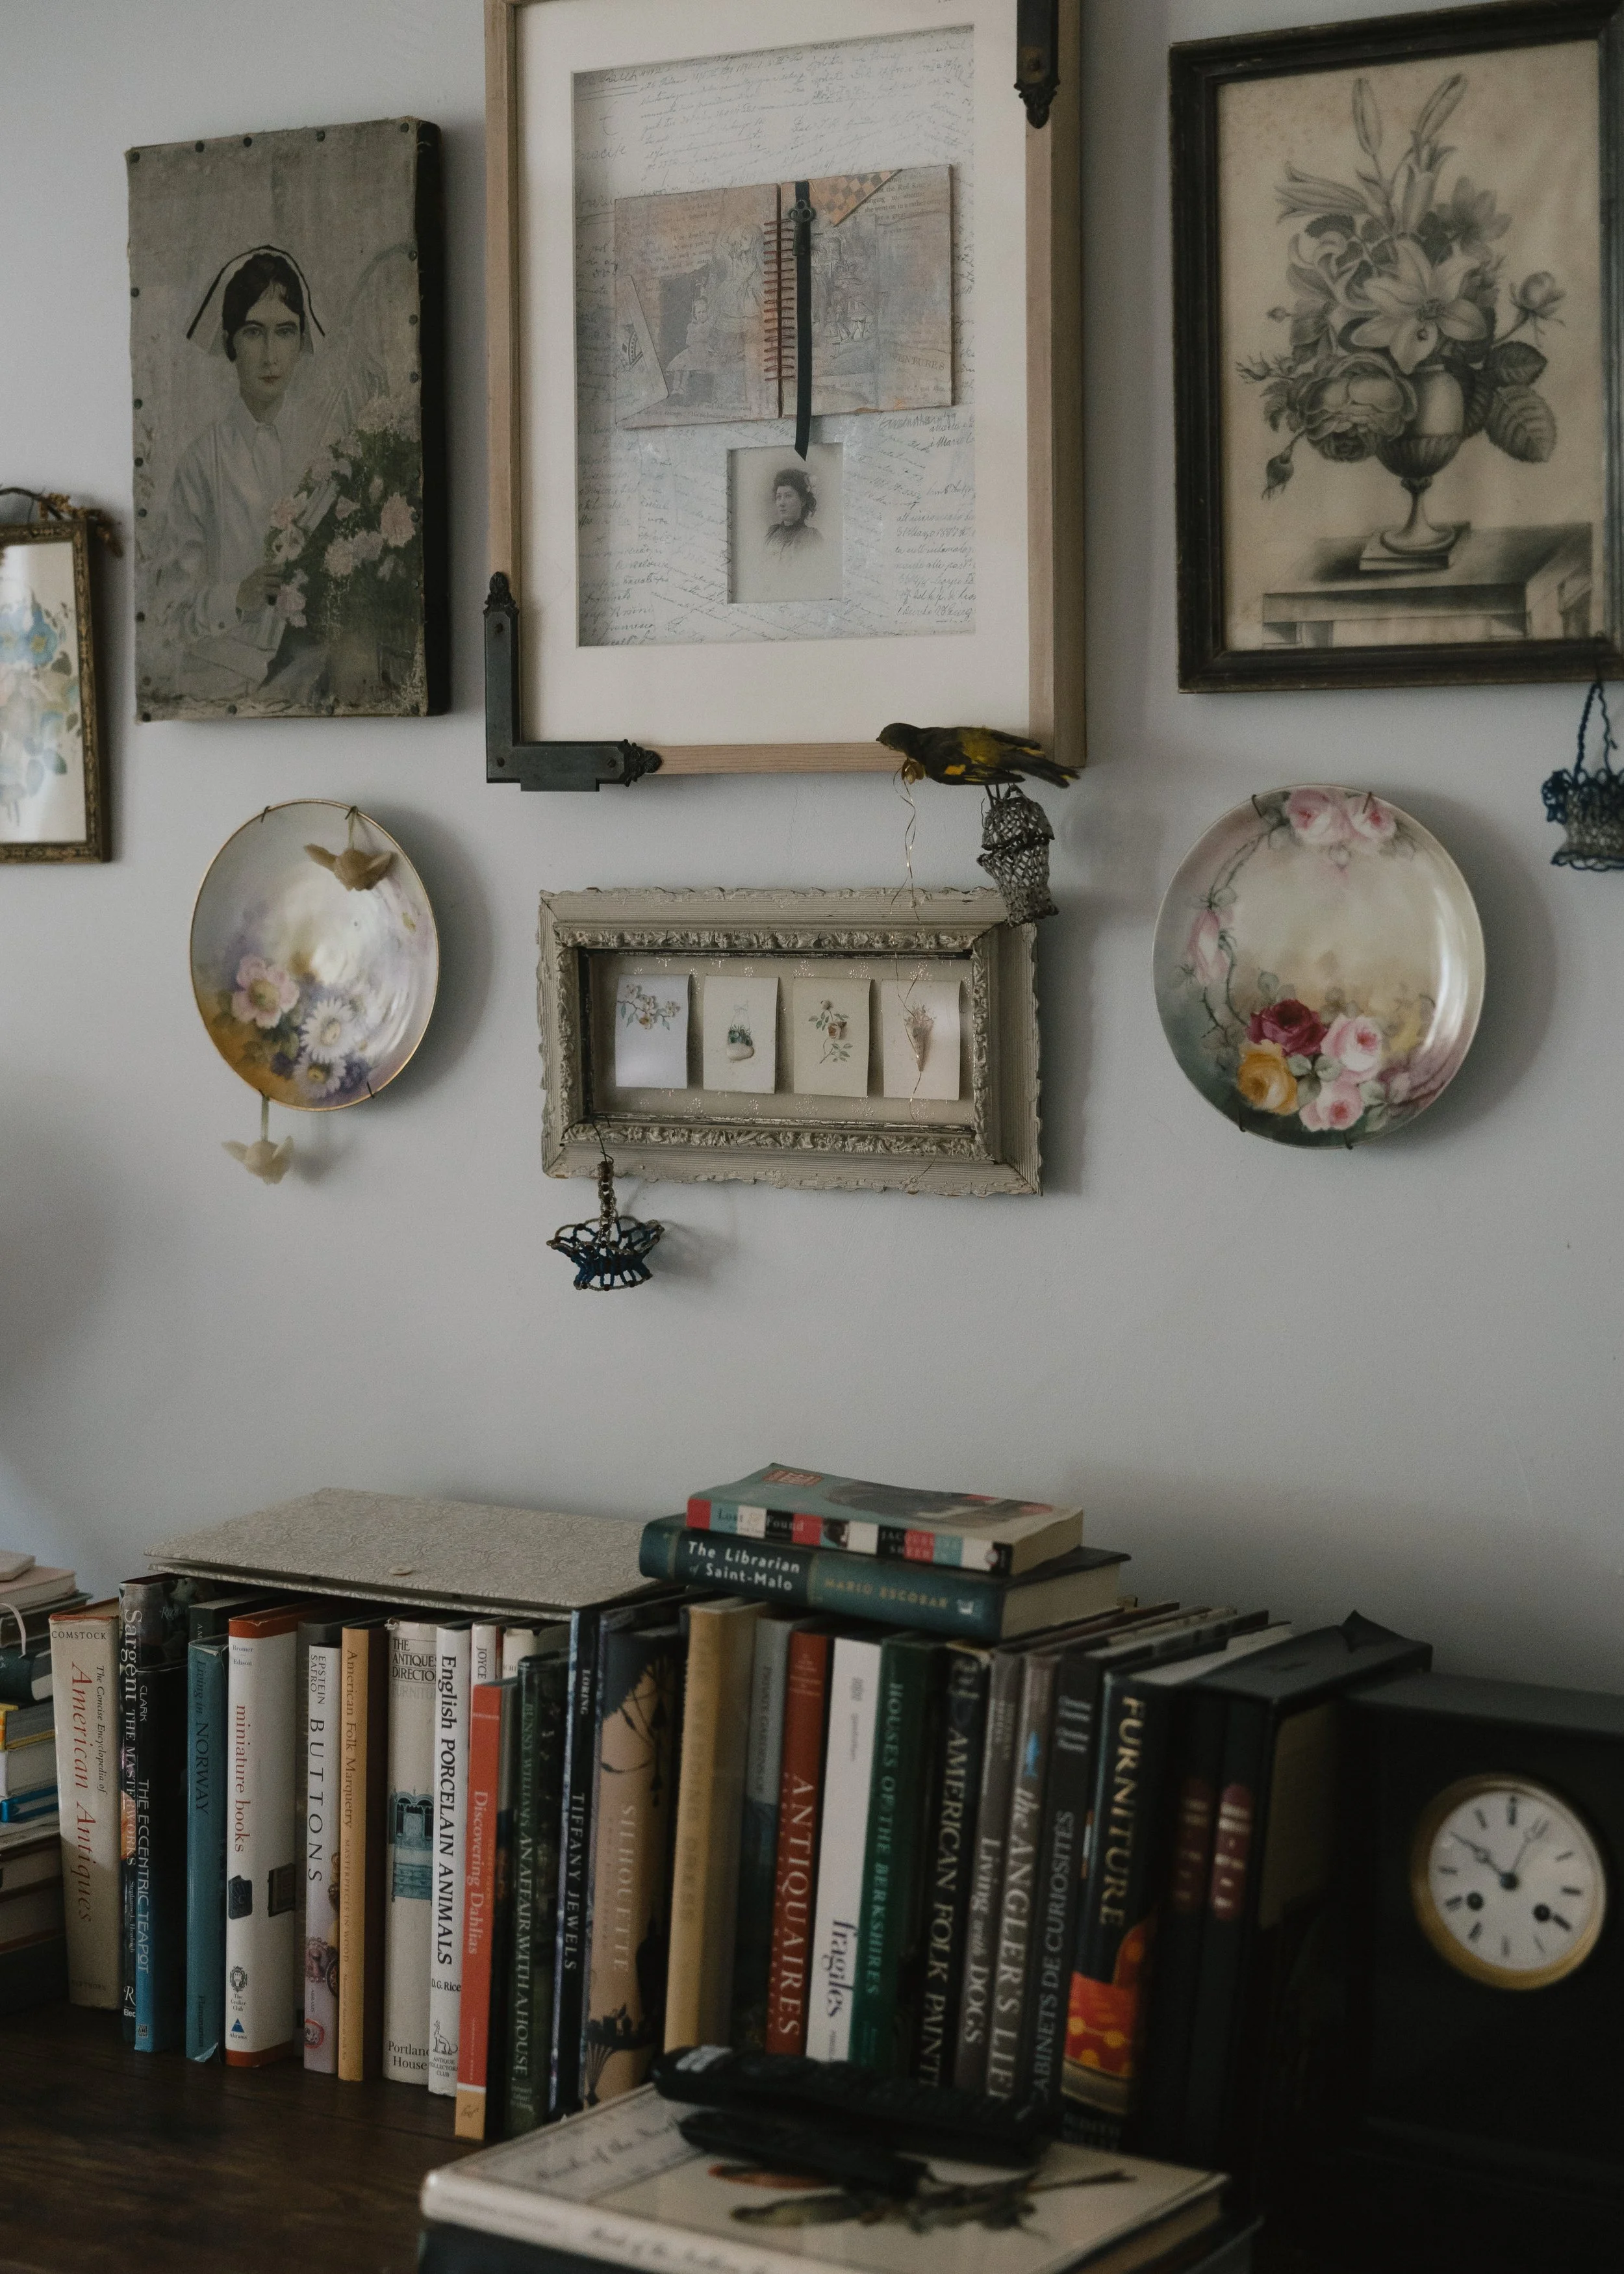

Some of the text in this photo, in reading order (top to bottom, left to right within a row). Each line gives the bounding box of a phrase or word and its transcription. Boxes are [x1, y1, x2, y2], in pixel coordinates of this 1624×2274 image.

[689, 1540, 800, 1574] The Librarian
[766, 1515, 804, 1531] Found
[705, 1562, 793, 1591] Saint-Malo
[823, 1578, 949, 1609] MARIO ESCOBAR
[51, 1629, 107, 1640] COMSTOCK
[231, 1644, 254, 1654] Bromer
[233, 1658, 253, 1667] Edison
[392, 1638, 410, 1651] THE
[476, 1645, 487, 1680] JOYCE
[140, 1685, 149, 1722] CLARK
[309, 1654, 318, 1694] SAFRO
[318, 1655, 326, 1705] EPSTEIN
[580, 1668, 592, 1715] LORING
[96, 1665, 108, 1795] The Concise Encyclopedia of
[121, 1610, 144, 1866] Sargent THE MASTERWORKS
[193, 1660, 210, 1815] Living in NORWAY
[342, 1649, 358, 1830] American Folk Marquetry
[70, 1661, 96, 1923] American Antiques
[234, 1704, 251, 1852] miniature books
[308, 1718, 325, 1882] BUTTONS
[437, 1655, 458, 1966] English PORCELAIN ANIMALS
[520, 1757, 533, 1832] WILLIAMS
[936, 1726, 970, 1892] AMERICAN
[1099, 1694, 1146, 1928] FURNITURE
[466, 1791, 488, 1956] Discovering Dahlias
[865, 1682, 904, 1995] HOUSES OF THE BERKSHIRES
[136, 1779, 150, 1974] THE ECCENTRIC TEAPOT
[342, 1839, 351, 1963] MASTERPIECES IN WOOD
[517, 1863, 533, 1933] AFFAIR
[564, 1793, 586, 1971] TIFFANY JEWELS
[613, 1804, 635, 1972] SILHOUETTE
[779, 1774, 815, 2036] ANTIQUAIRES
[971, 1837, 1002, 1915] Living
[927, 1902, 955, 1983] FOLK
[996, 1833, 1035, 2014] ANGLER'S
[431, 1978, 461, 1992] D.G. Rice
[515, 1932, 531, 1989] WITH
[1041, 1956, 1061, 1989] DE
[517, 1991, 529, 2010] A
[963, 1965, 990, 2043] DOGS
[229, 2032, 248, 2040] Abrams
[393, 2055, 428, 2071] House
[433, 2055, 455, 2065] ANTIQUE
[513, 2013, 529, 2077] HOUSE
[436, 2069, 450, 2078] CLUB
